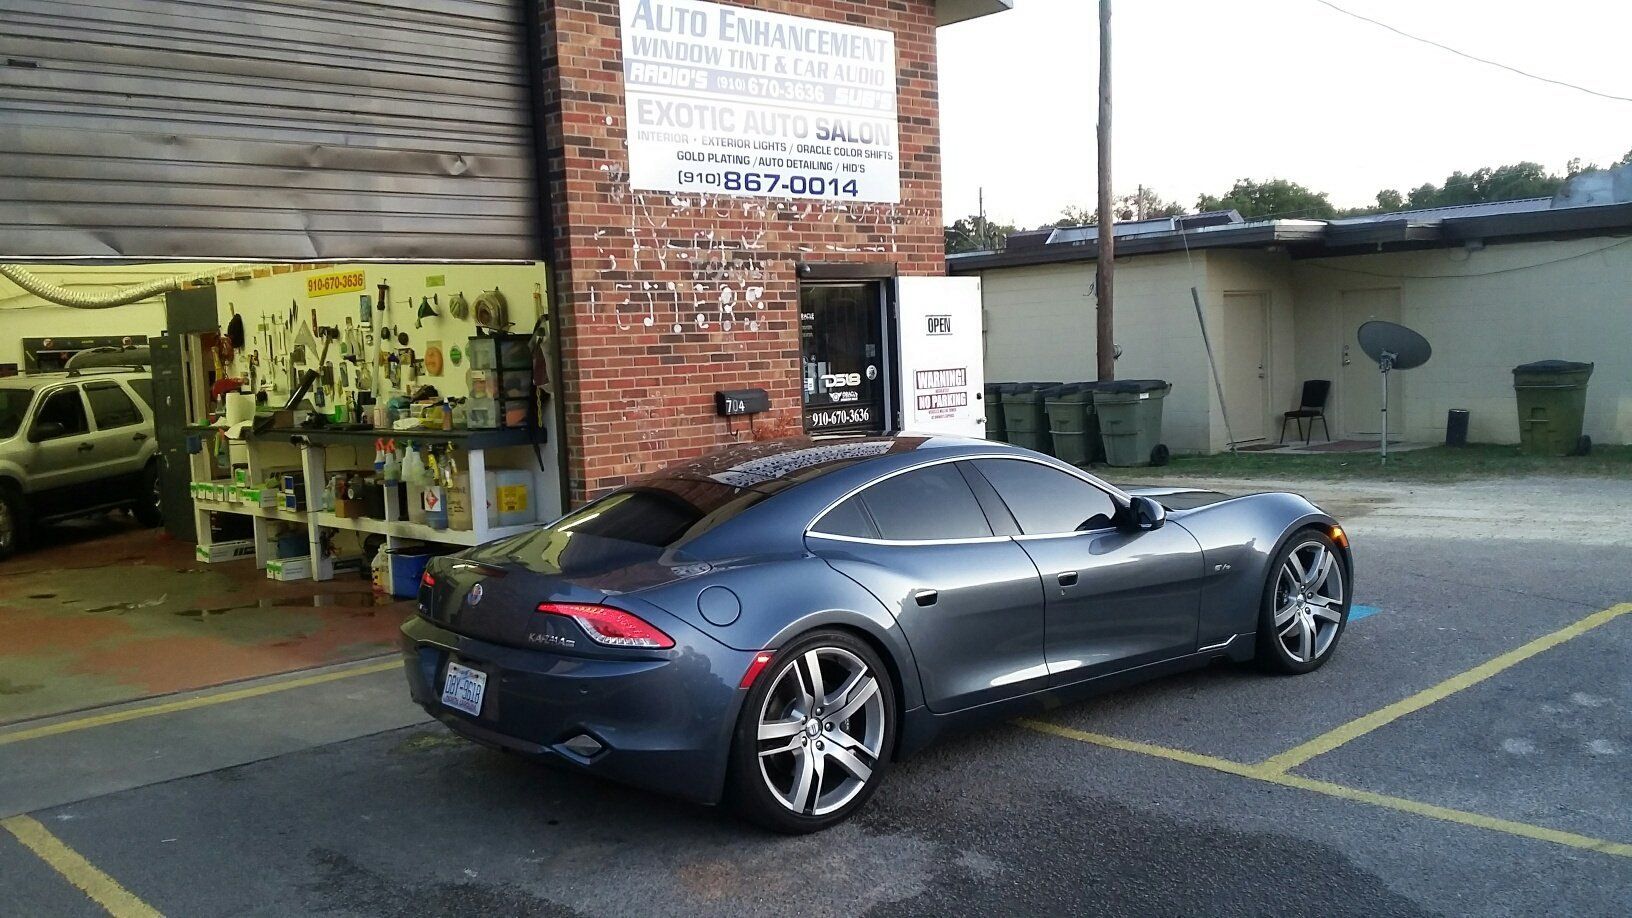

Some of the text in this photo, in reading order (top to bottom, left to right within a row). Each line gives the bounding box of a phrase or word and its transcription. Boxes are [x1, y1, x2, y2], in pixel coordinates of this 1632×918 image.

[630, 0, 889, 63] AUTO ENHANCEMENT
[631, 35, 885, 87] WINDOW TINT & CAR AUDIO
[630, 62, 709, 90] RADIO'S
[637, 98, 891, 146] EXOTIC AUTO SALON
[637, 130, 689, 144] INTERIOR
[701, 135, 751, 149] EXTERIOR
[753, 141, 787, 152] LIGHTS
[796, 144, 832, 156] ORACLE
[833, 147, 863, 158] COLOR
[864, 149, 894, 161] SHIFTS
[676, 150, 705, 162] GOLD
[707, 152, 751, 166] PLATING
[786, 158, 833, 172] DETAILING
[842, 162, 866, 174] HID'S
[308, 273, 364, 292] 910-670-3636
[927, 317, 951, 333] OPEN
[917, 369, 966, 389] WARNING!
[725, 399, 746, 413] 704
[918, 392, 967, 410] NO PARKING
[812, 407, 870, 427] 910-670-3636
